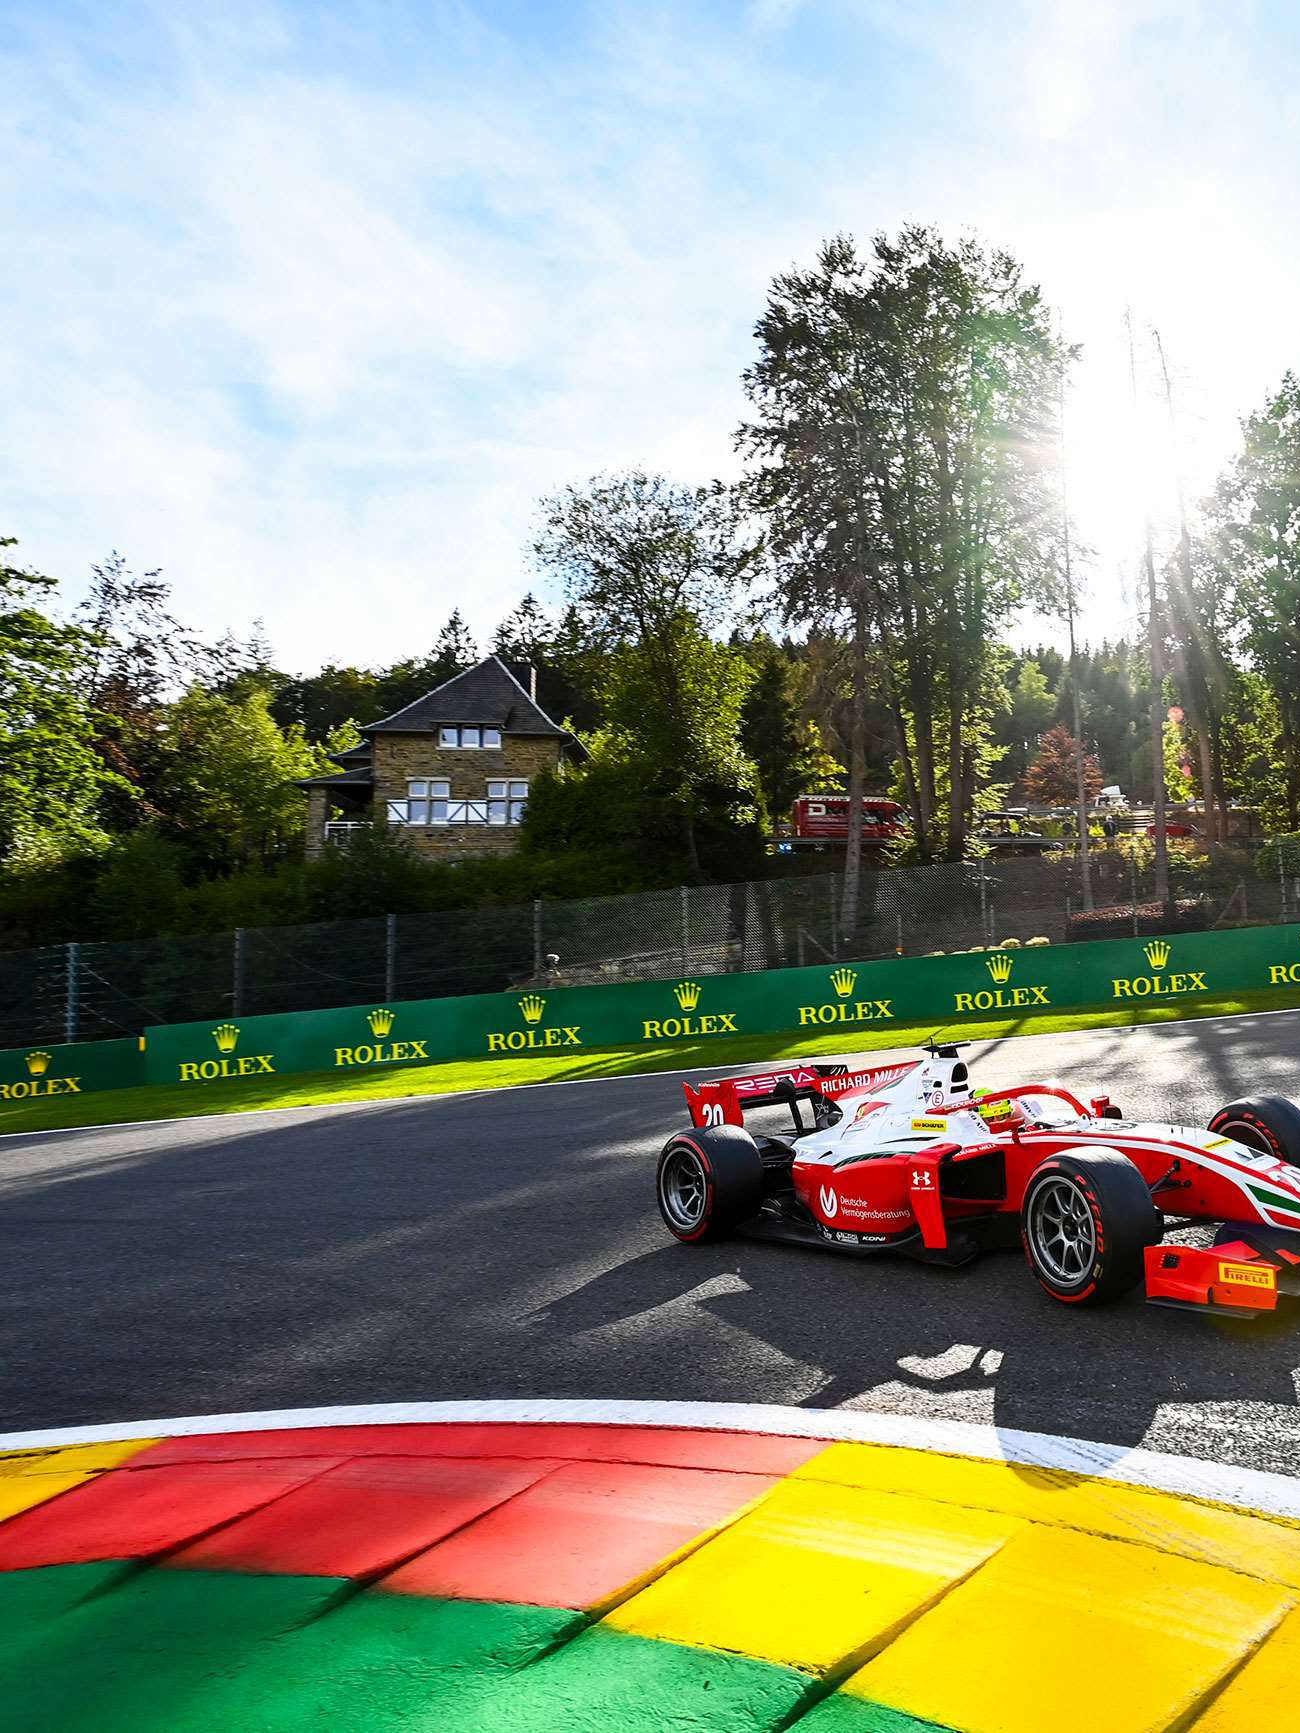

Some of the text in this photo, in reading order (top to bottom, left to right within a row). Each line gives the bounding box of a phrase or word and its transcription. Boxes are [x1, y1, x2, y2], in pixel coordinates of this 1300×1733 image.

[1112, 972, 1209, 997] ROLEX
[954, 986, 1052, 1011] ROLEX
[798, 999, 894, 1024] ROLEX
[642, 1013, 738, 1038] ROLEX
[487, 1026, 583, 1051] ROLEX
[334, 1040, 429, 1065] ROLEX
[179, 1055, 277, 1080] ROLEX
[0, 1077, 82, 1099] ROLEX
[821, 1074, 871, 1094] RICHARD
[873, 1067, 909, 1085] MILLE
[702, 1103, 725, 1127] 20
[840, 1195, 868, 1208] Deutsche
[841, 1207, 911, 1220] Vermögensberatung
[1223, 1267, 1269, 1285] PIRELLI
